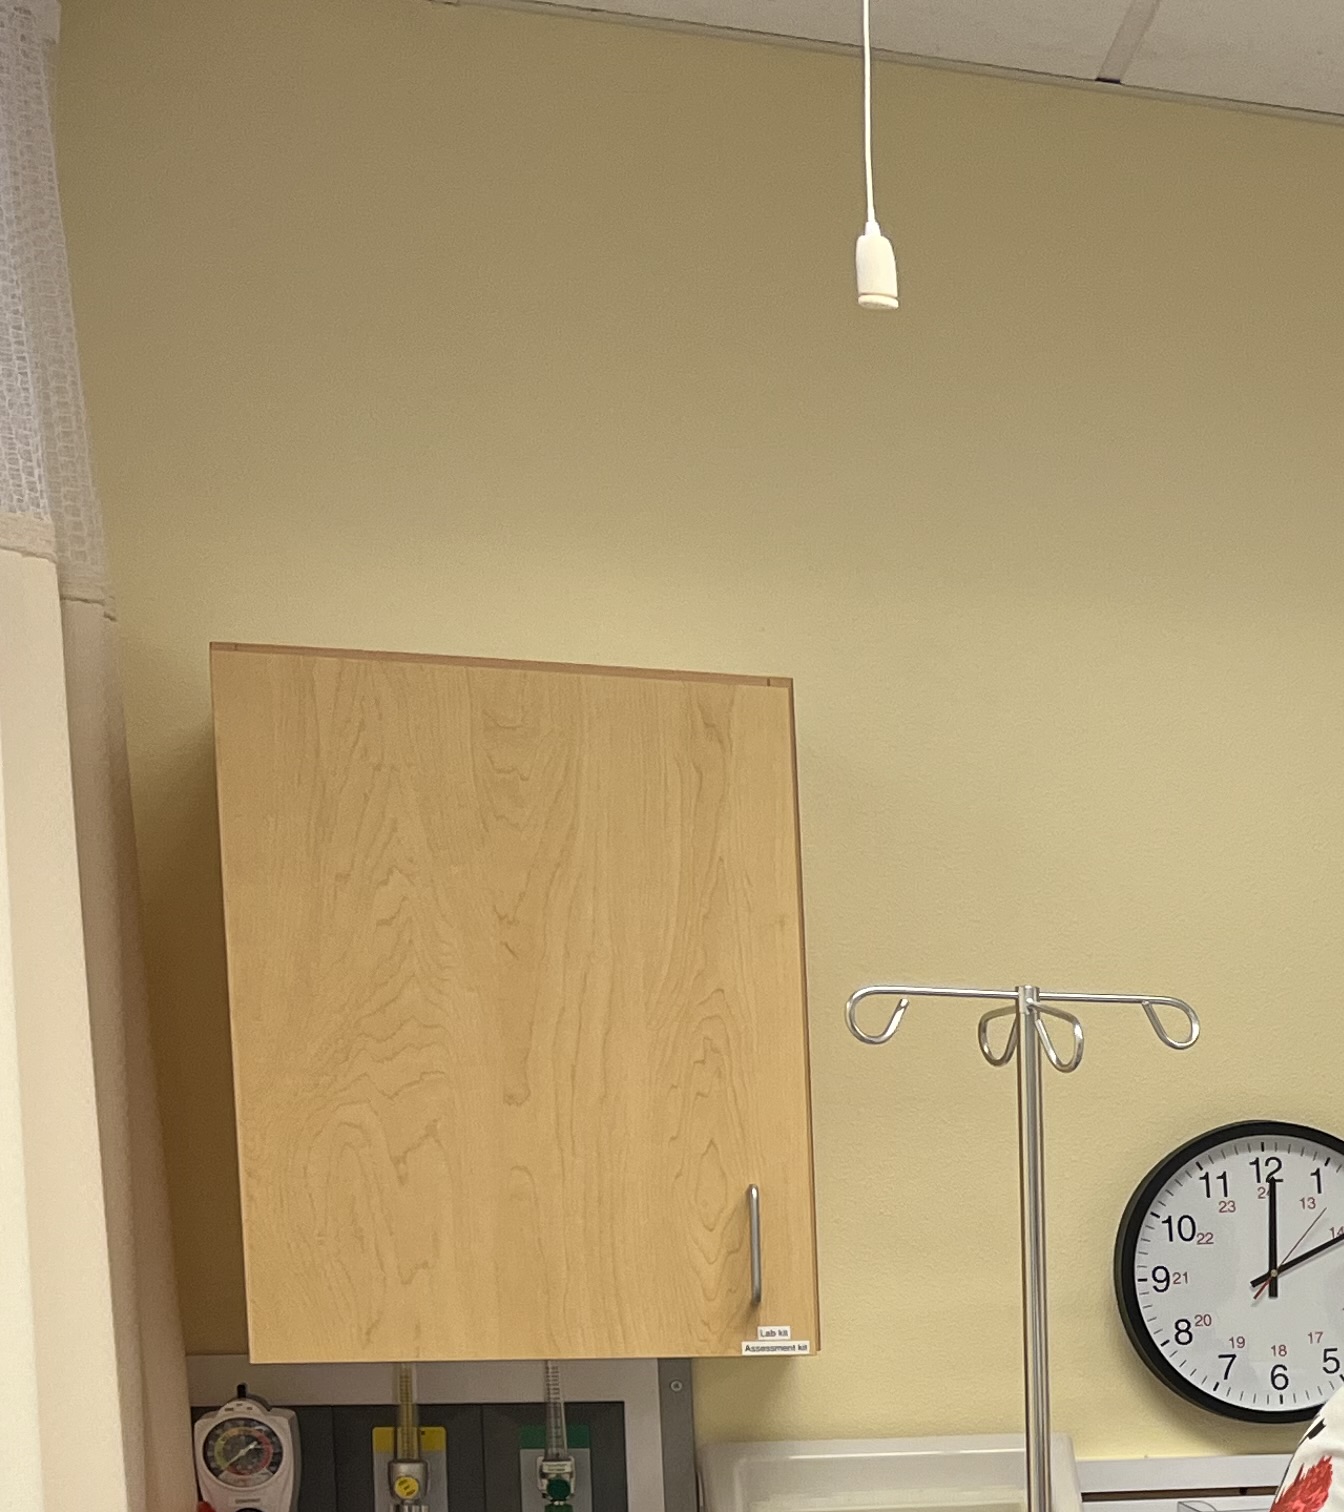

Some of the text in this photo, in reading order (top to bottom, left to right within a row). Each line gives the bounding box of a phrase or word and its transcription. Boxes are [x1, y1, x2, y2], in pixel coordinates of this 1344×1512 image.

[1249, 1157, 1283, 1183] 12
[1199, 1171, 1228, 1199] 11
[1310, 1168, 1322, 1194] 1
[1219, 1200, 1236, 1214] 23
[1300, 1197, 1317, 1210] 13
[1162, 1215, 1197, 1243] 10
[1197, 1232, 1214, 1245] 22
[1151, 1266, 1170, 1293] 9
[1173, 1272, 1189, 1285] 21
[1194, 1314, 1212, 1327] 20
[760, 1329, 776, 1337] Lab
[1174, 1319, 1193, 1346] 8
[1308, 1332, 1323, 1345] 17
[745, 1344, 795, 1352] Assessment
[1229, 1336, 1245, 1349] 19
[1271, 1345, 1287, 1358] 18
[1218, 1354, 1236, 1380] 7
[1322, 1348, 1341, 1374] 5
[1270, 1364, 1289, 1391] 6
